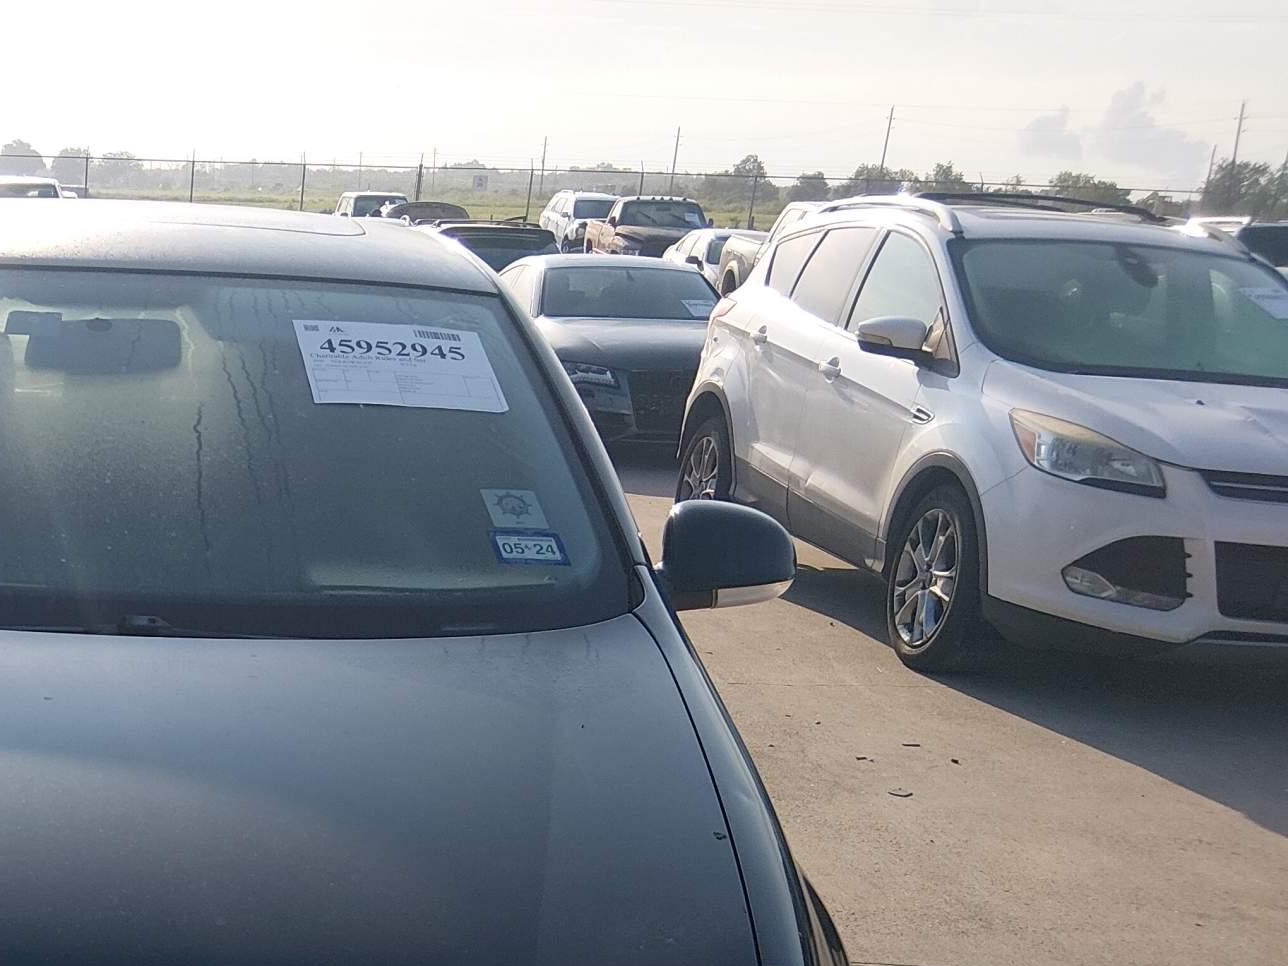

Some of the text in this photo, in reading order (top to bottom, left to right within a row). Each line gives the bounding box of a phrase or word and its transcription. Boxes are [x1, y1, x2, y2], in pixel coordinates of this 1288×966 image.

[319, 338, 466, 361] 45952945
[501, 542, 556, 555] 05 24
